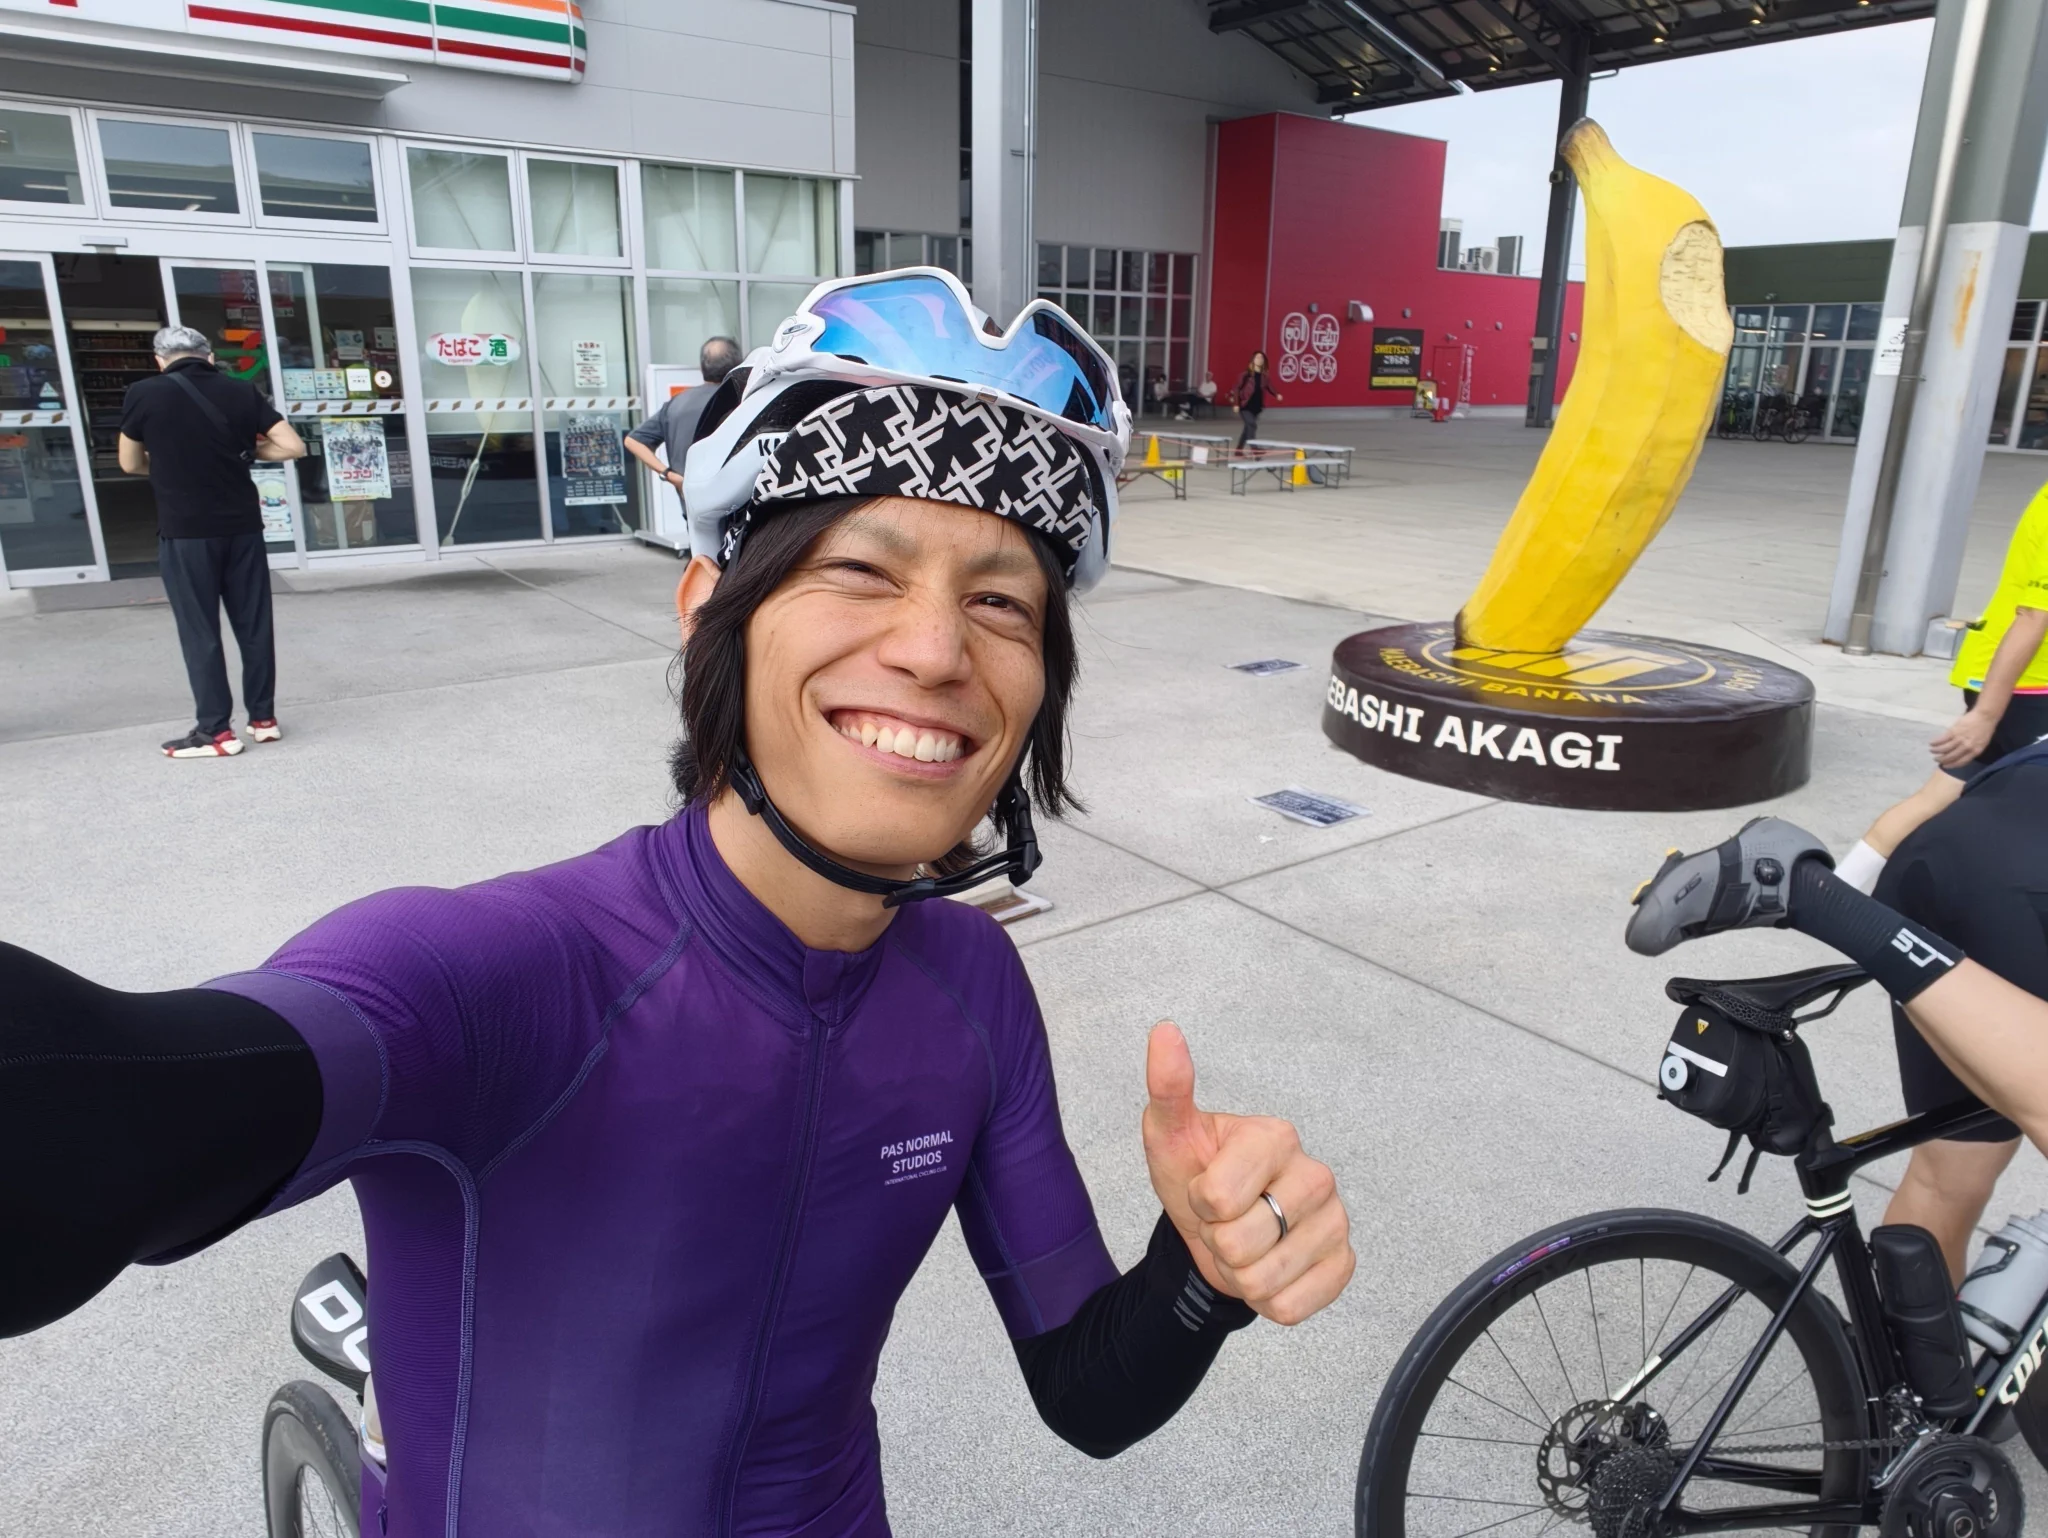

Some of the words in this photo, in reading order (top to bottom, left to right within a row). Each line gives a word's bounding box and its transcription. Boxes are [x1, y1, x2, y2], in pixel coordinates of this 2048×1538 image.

[437, 338, 482, 357] たばこ
[488, 338, 508, 357] 酒
[1379, 648, 1476, 686] MAEBASHI
[1480, 682, 1648, 705] BANANA
[1433, 715, 1624, 771] AKAGI
[880, 1142, 904, 1160] PAS
[905, 1130, 954, 1153] NORMAL
[892, 1150, 942, 1174] STUDIOS
